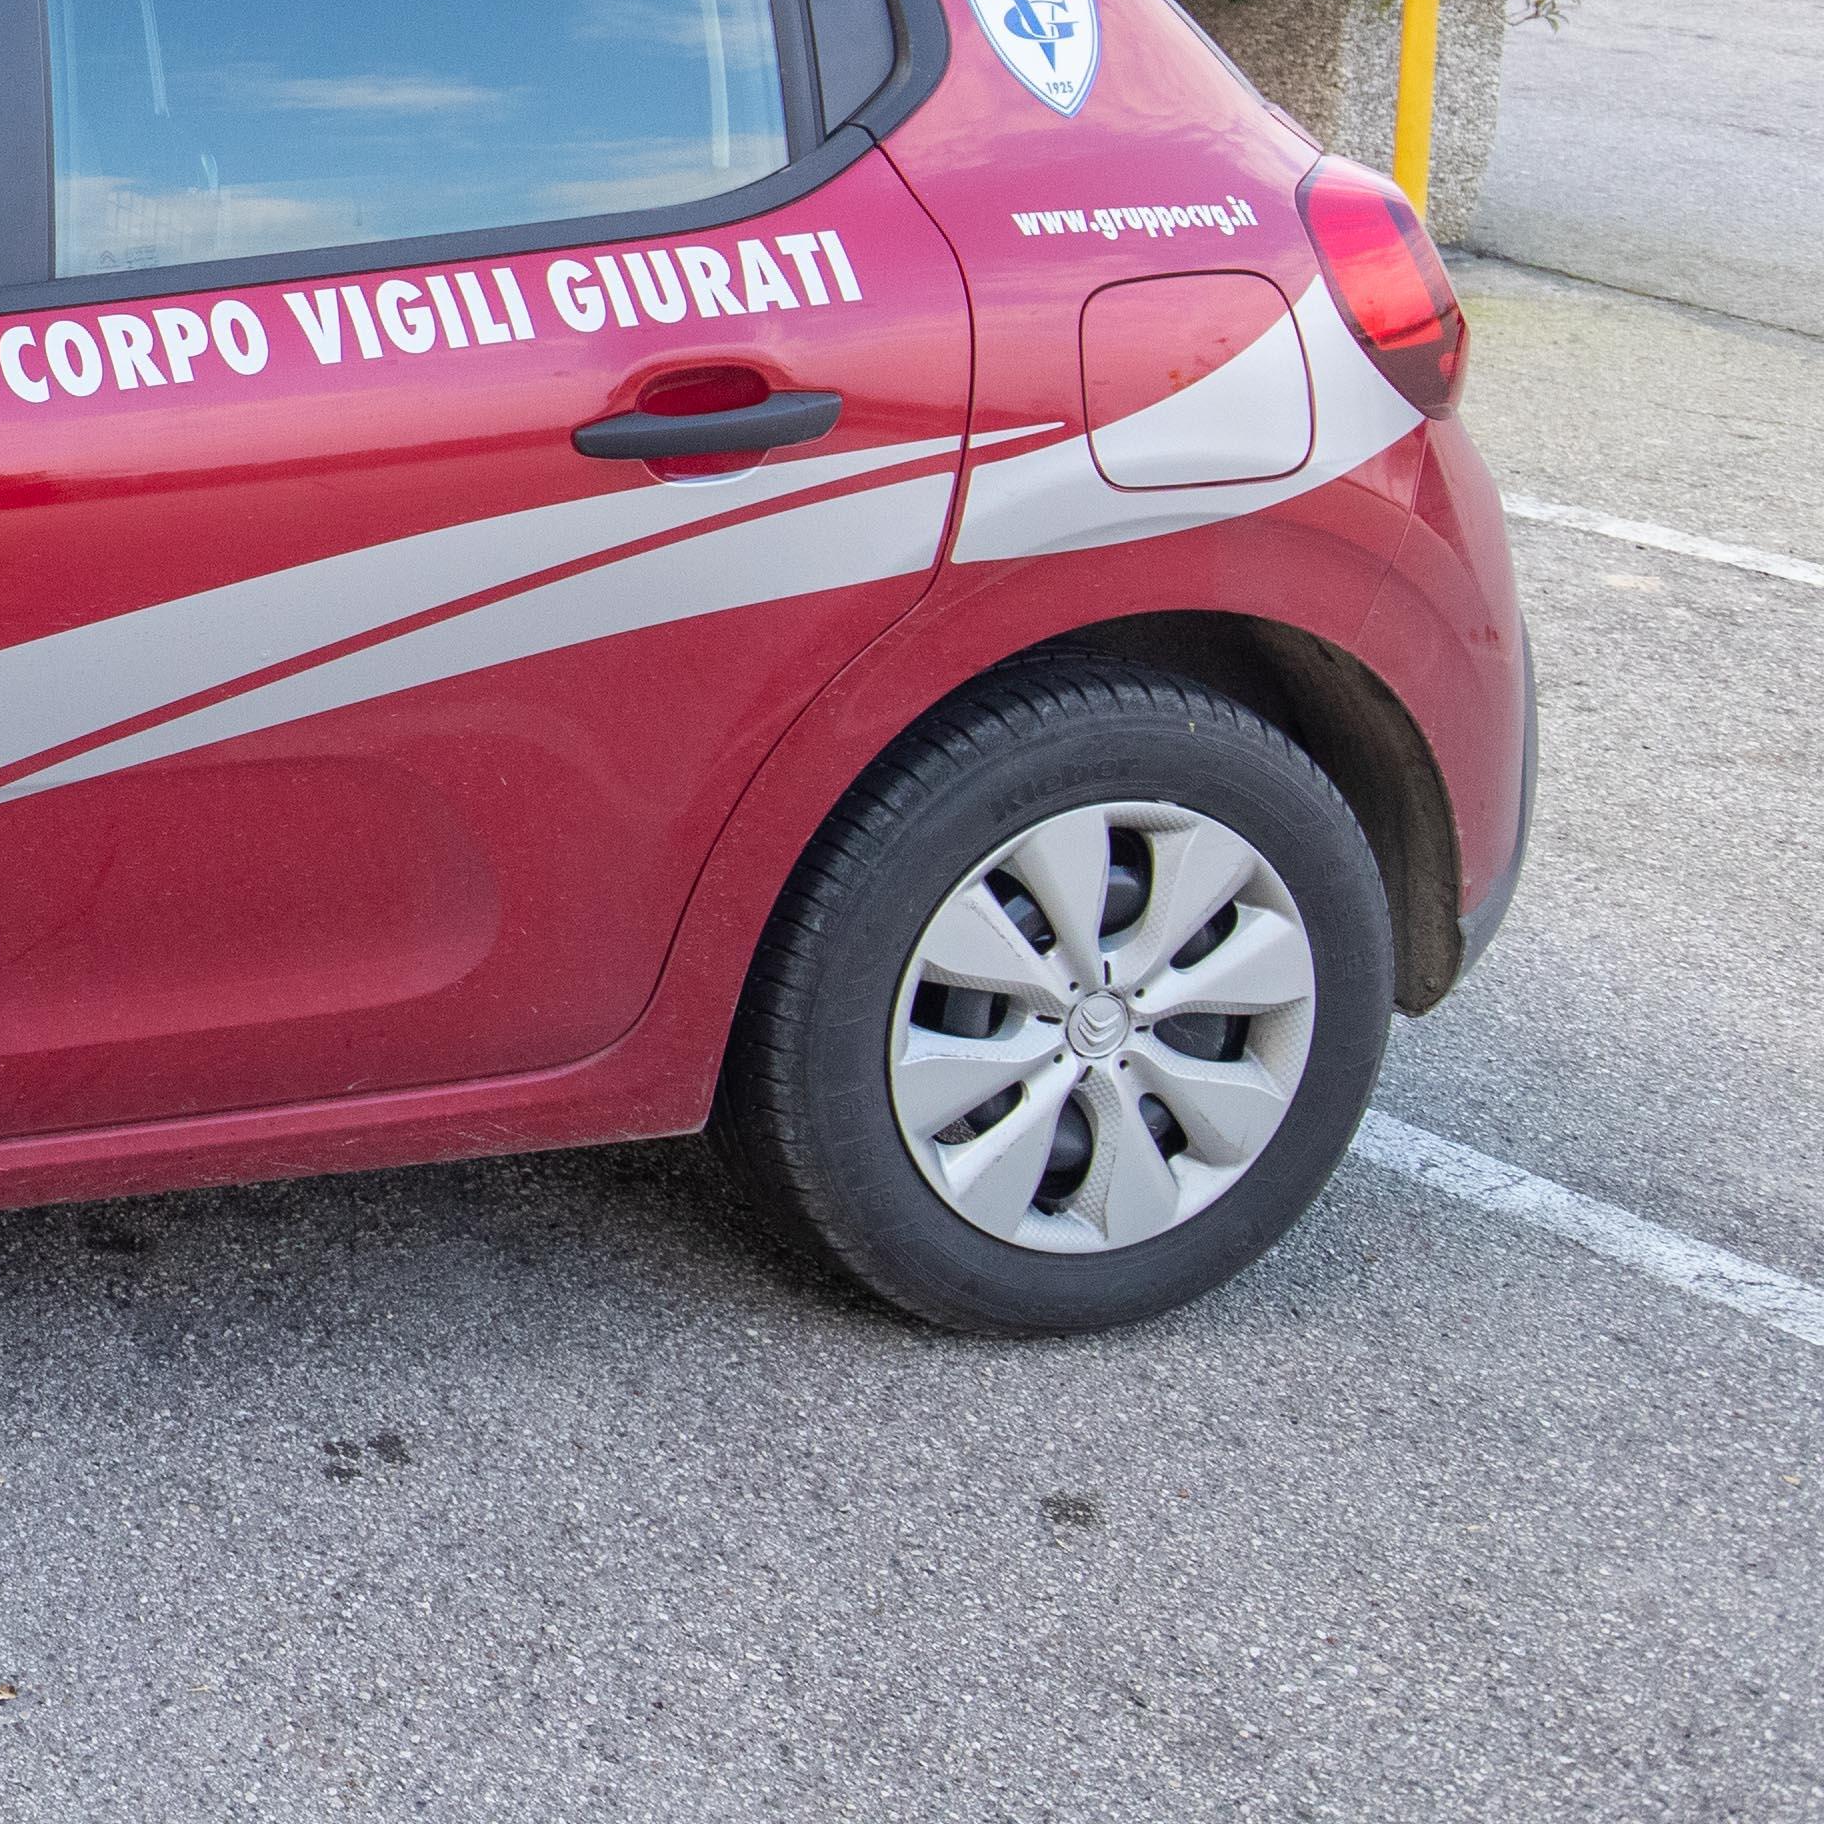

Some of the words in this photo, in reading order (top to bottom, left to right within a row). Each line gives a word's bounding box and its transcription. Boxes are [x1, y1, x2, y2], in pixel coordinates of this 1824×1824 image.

[1046, 80, 1075, 95] 1925
[1010, 194, 1259, 241] www.gruppocvg.it
[283, 266, 536, 366] VIGILI
[546, 229, 863, 334] GIURATI
